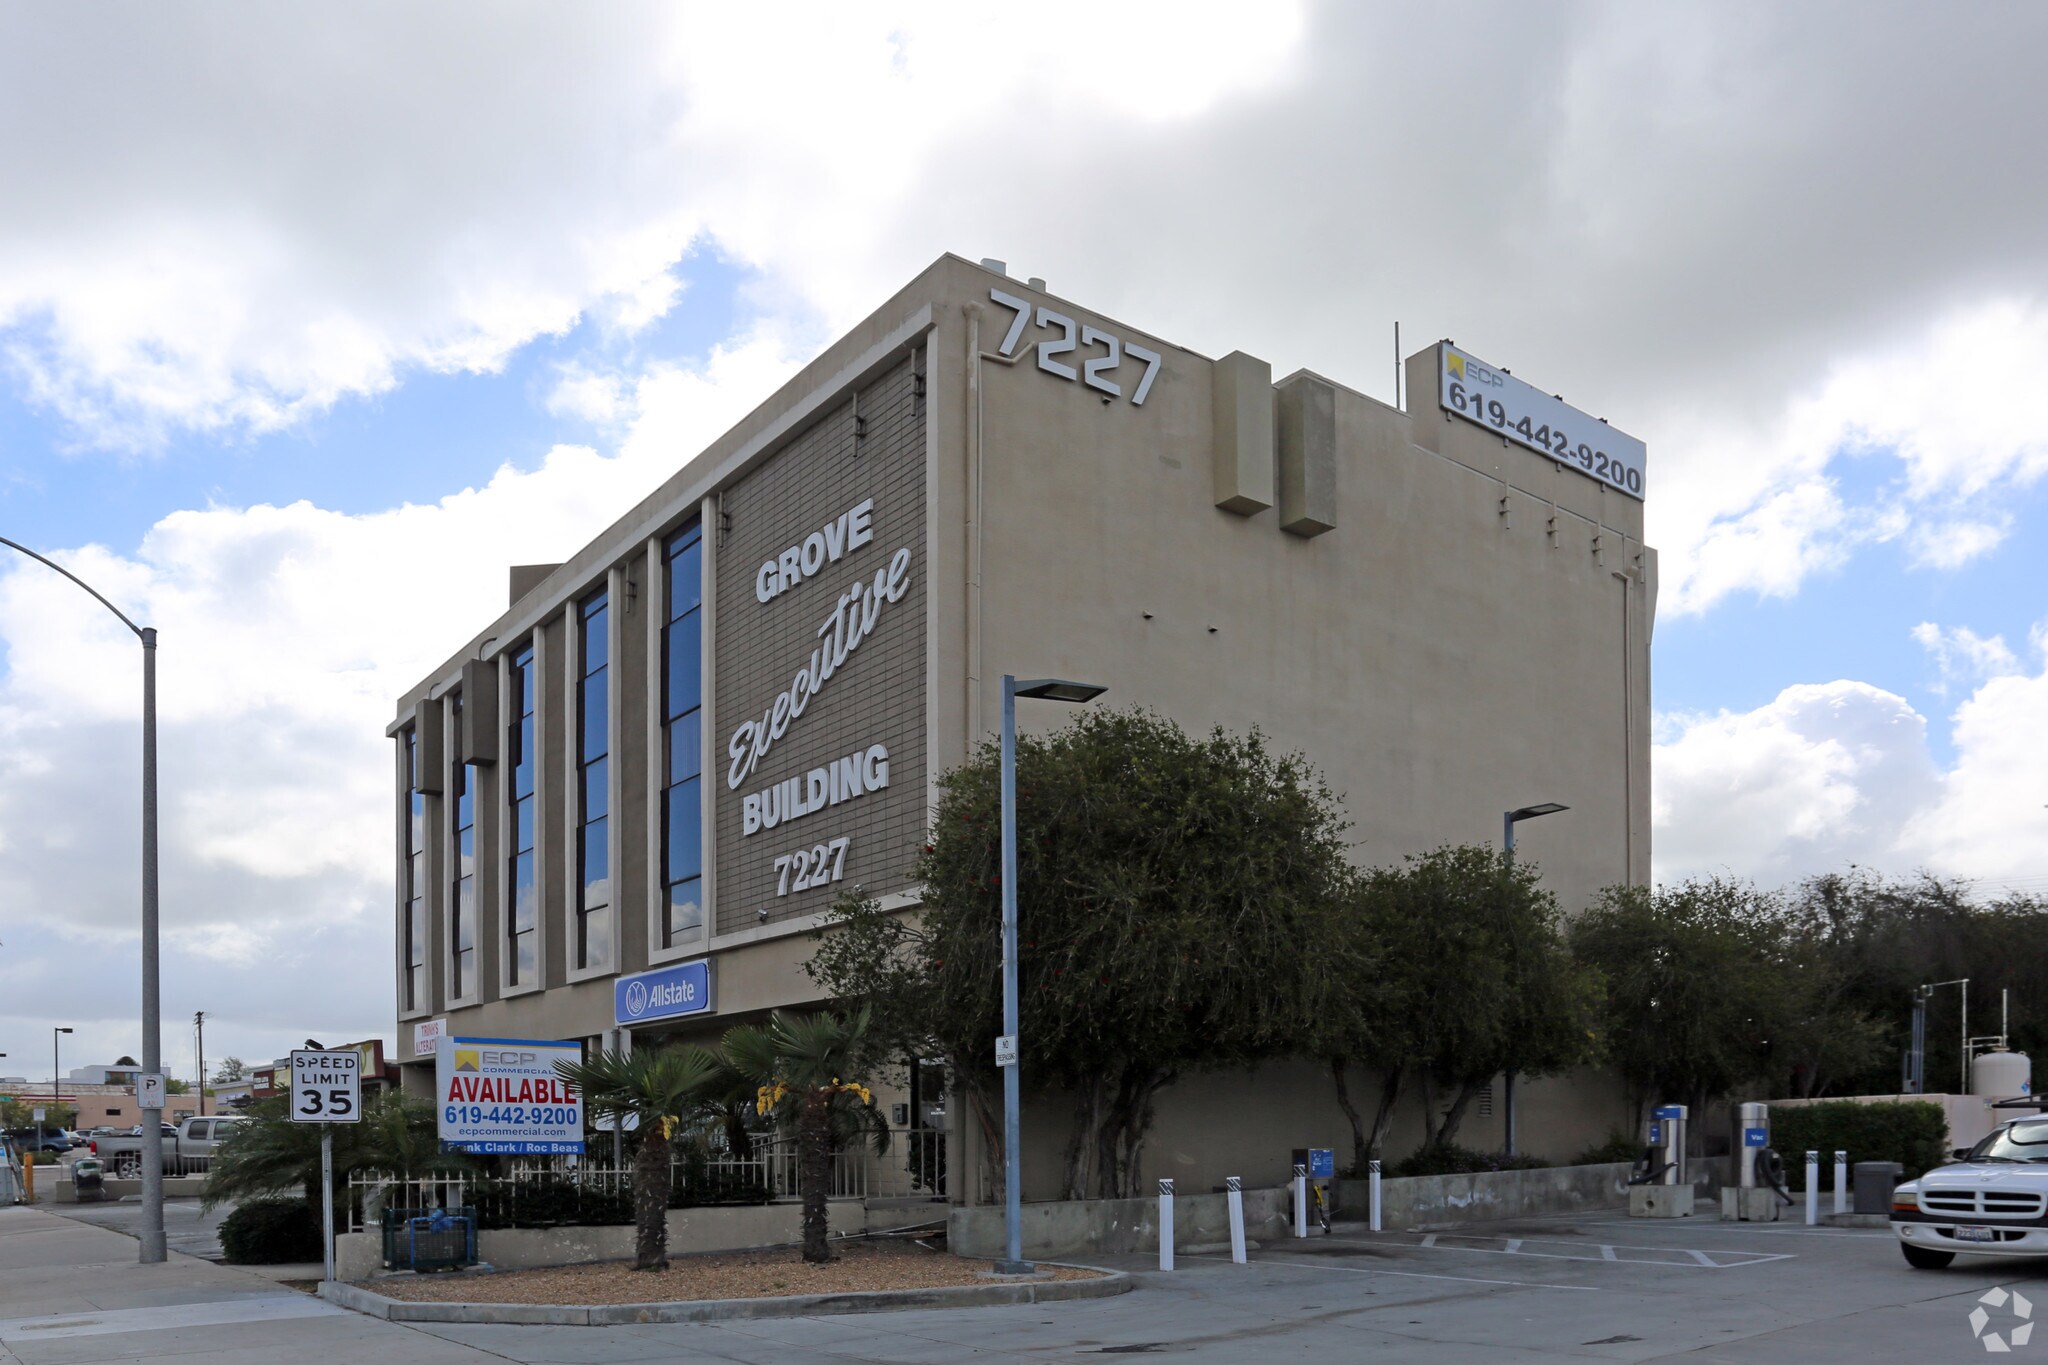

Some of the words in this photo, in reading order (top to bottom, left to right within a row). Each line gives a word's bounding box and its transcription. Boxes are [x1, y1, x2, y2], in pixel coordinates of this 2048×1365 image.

[990, 287, 1161, 406] 7227
[1466, 361, 1503, 388] ECP
[1449, 382, 1641, 494] 619-442-9200
[756, 498, 874, 603] GROVE
[727, 547, 912, 790] Executive
[743, 744, 889, 836] BUILDING
[774, 837, 850, 897] 7227
[648, 980, 695, 1008] Allstate
[295, 1057, 355, 1069] SPEED
[482, 1051, 537, 1066] ECP
[482, 1067, 554, 1075] COMMERCIAL
[301, 1074, 350, 1085] LIMIT
[448, 1076, 577, 1105] AVAILABLE
[300, 1089, 353, 1115] 35
[445, 1105, 577, 1125] 619-442-9200
[458, 1127, 566, 1136] ecpcommercial.com
[485, 1142, 516, 1152] Clark
[526, 1143, 548, 1152] Roc
[551, 1143, 579, 1152] Beas
